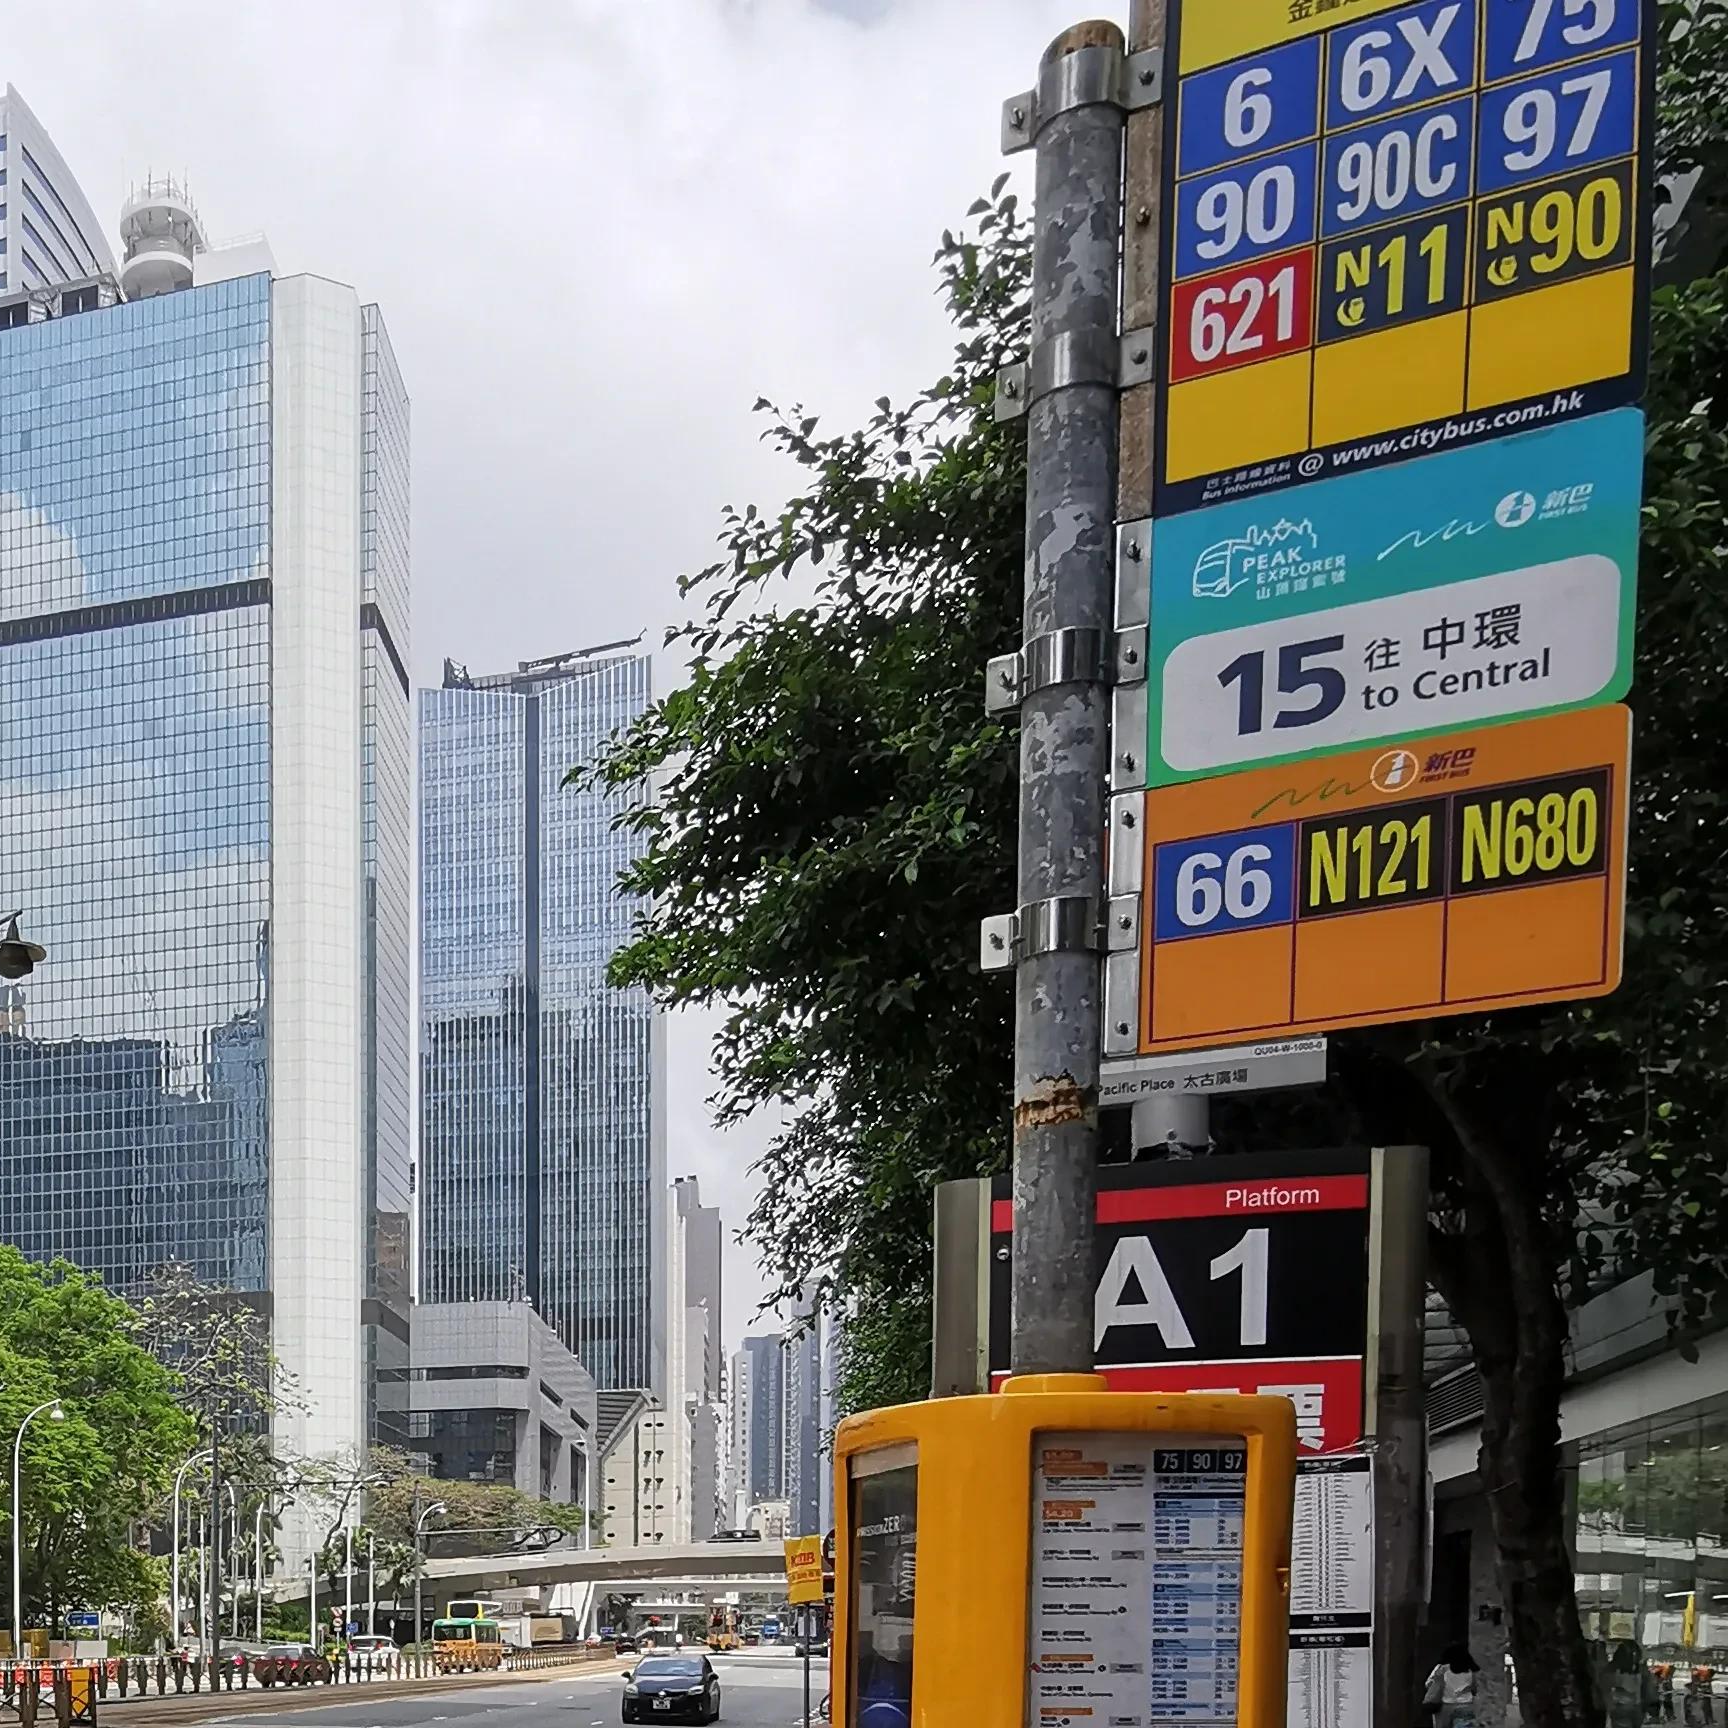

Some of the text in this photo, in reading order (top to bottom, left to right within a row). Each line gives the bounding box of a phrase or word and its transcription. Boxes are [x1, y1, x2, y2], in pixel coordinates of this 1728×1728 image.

[1224, 68, 1272, 148] 6
[1339, 3, 1461, 112] 6X
[1196, 70, 1612, 260] 90 90C 97
[1191, 176, 1622, 363] 621 N11 N90
[1332, 390, 1585, 467] www.citybus.com.hk
[1243, 546, 1302, 573] PEAK
[1257, 554, 1346, 584] EXPLORER
[1363, 603, 1522, 673] 往 中環
[1217, 635, 1347, 737] 15
[1362, 648, 1551, 711] to Central
[1175, 786, 1598, 927] 66 N121 N680
[1140, 1079, 1175, 1092] Place
[1225, 1186, 1320, 1209] Platform
[1161, 1452, 1178, 1470] 75
[1192, 1452, 1211, 1470] 90
[1224, 1452, 1243, 1470] 97
